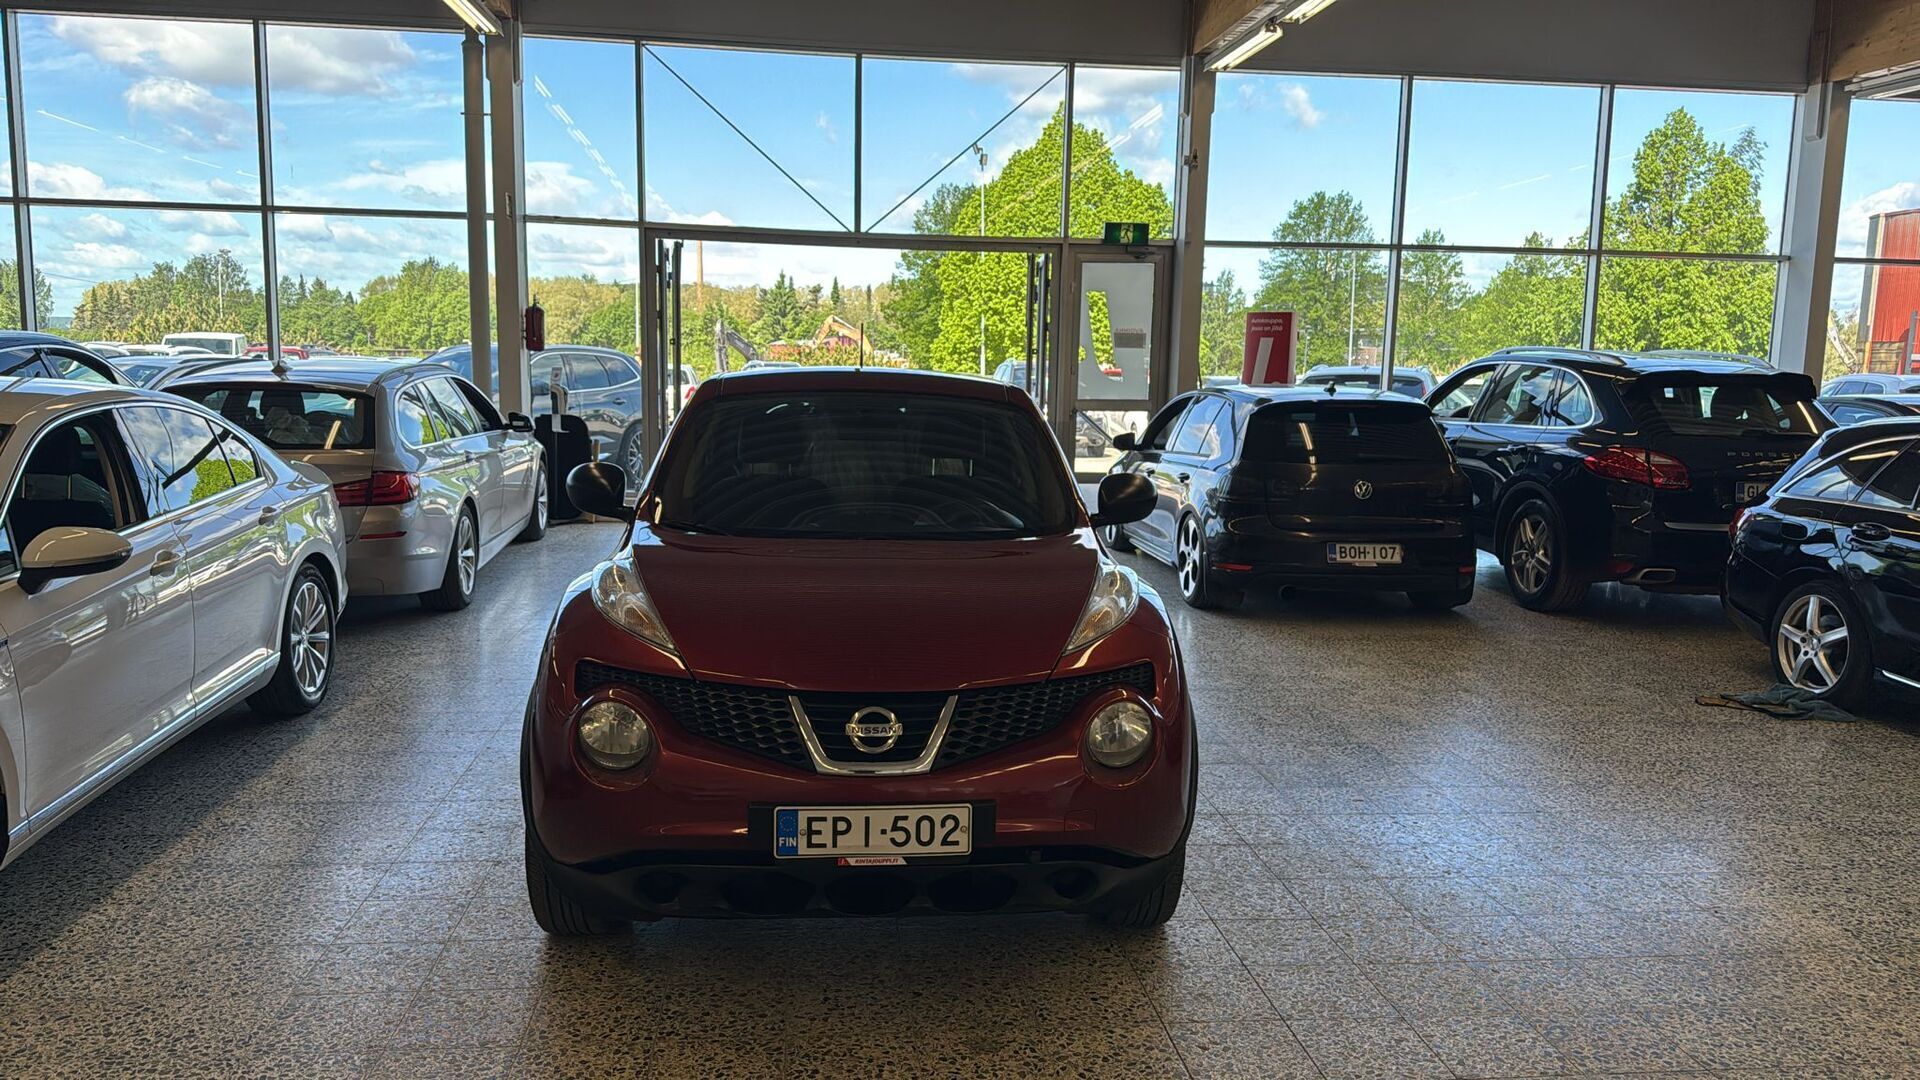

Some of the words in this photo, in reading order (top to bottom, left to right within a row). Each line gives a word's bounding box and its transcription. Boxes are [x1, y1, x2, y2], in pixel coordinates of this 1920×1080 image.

[1339, 546, 1397, 560] BOH-107
[851, 726, 897, 735] NISSAN
[806, 814, 960, 849] EPI-502
[779, 837, 797, 847] FIN
